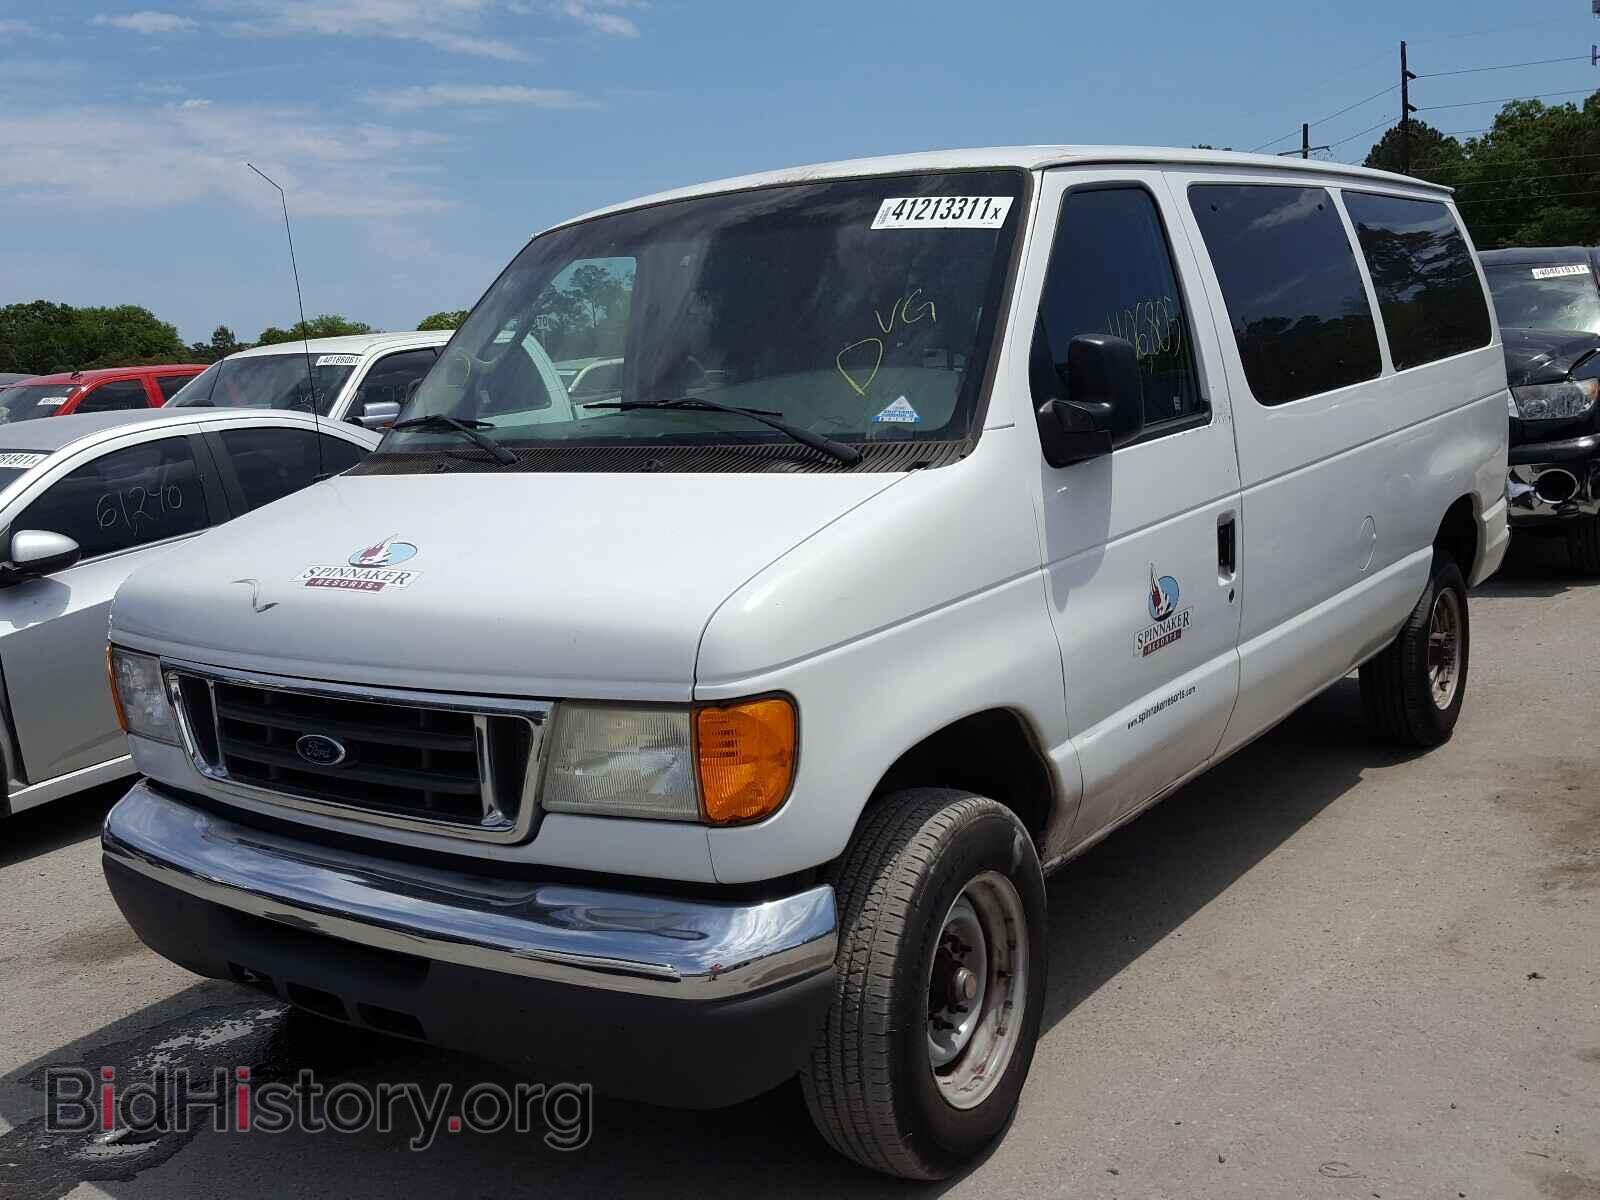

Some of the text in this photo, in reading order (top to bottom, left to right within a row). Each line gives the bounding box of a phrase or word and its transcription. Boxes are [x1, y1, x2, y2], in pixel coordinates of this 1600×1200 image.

[303, 566, 412, 586] SPINNAKER
[313, 578, 376, 590] RESORTS
[1137, 610, 1190, 650] SPINNAKER
